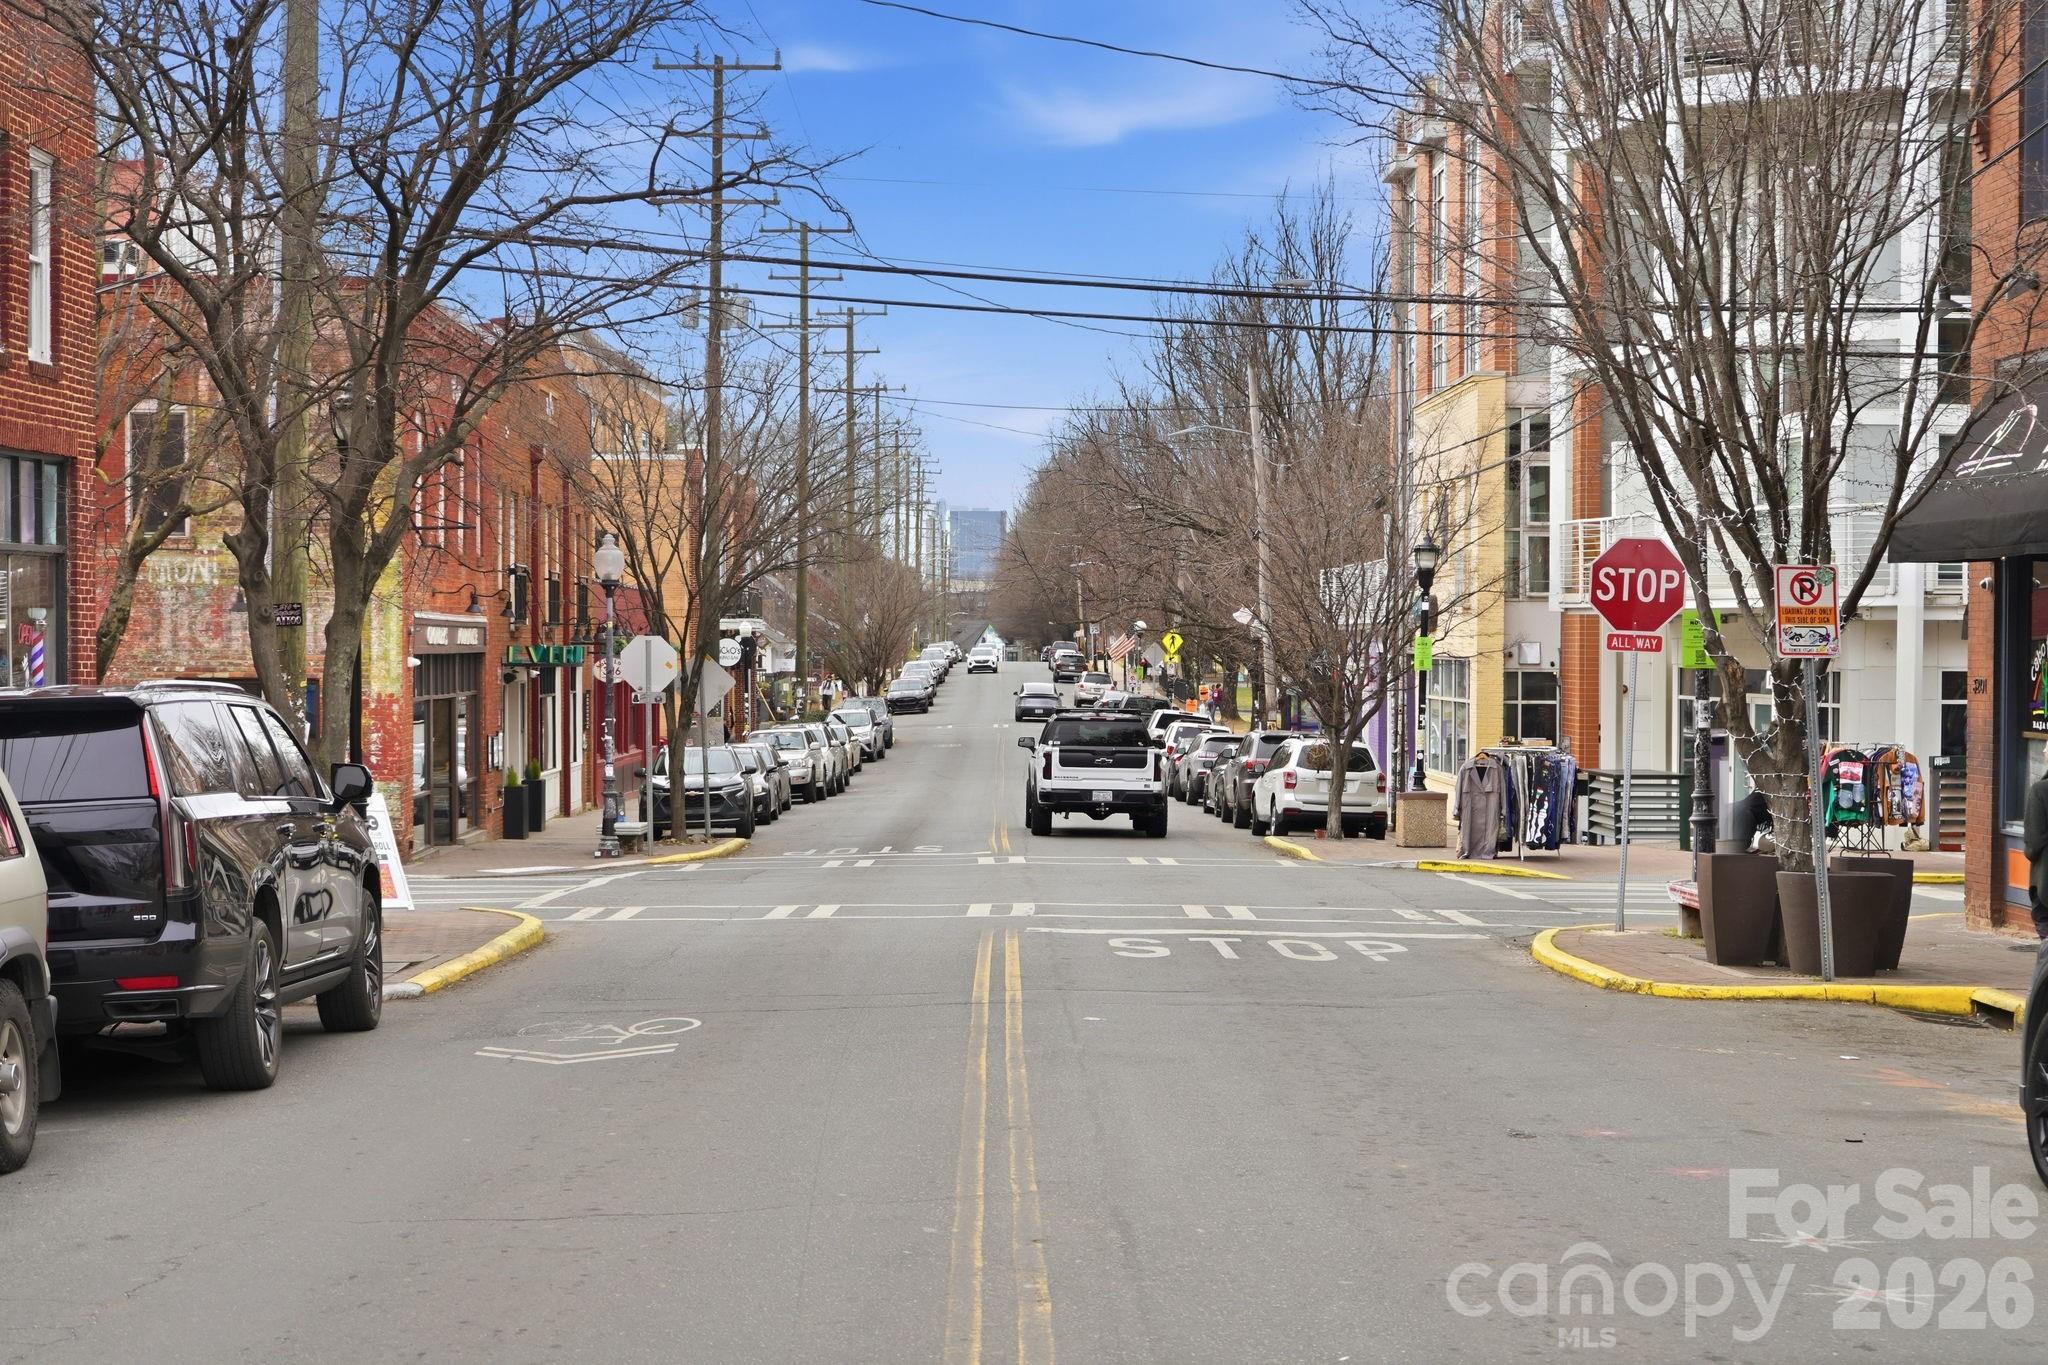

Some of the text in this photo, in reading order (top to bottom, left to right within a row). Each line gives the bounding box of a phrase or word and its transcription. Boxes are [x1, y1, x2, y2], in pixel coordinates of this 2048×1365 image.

[1596, 566, 1680, 603] STOP
[1782, 607, 1832, 616] LOADING ZONE ONLY
[276, 616, 302, 625] ATTOO
[1785, 616, 1830, 624] THIS SIDE OF SIGN
[1611, 636, 1658, 649] ALL WAY
[1108, 937, 1409, 962] STOP
